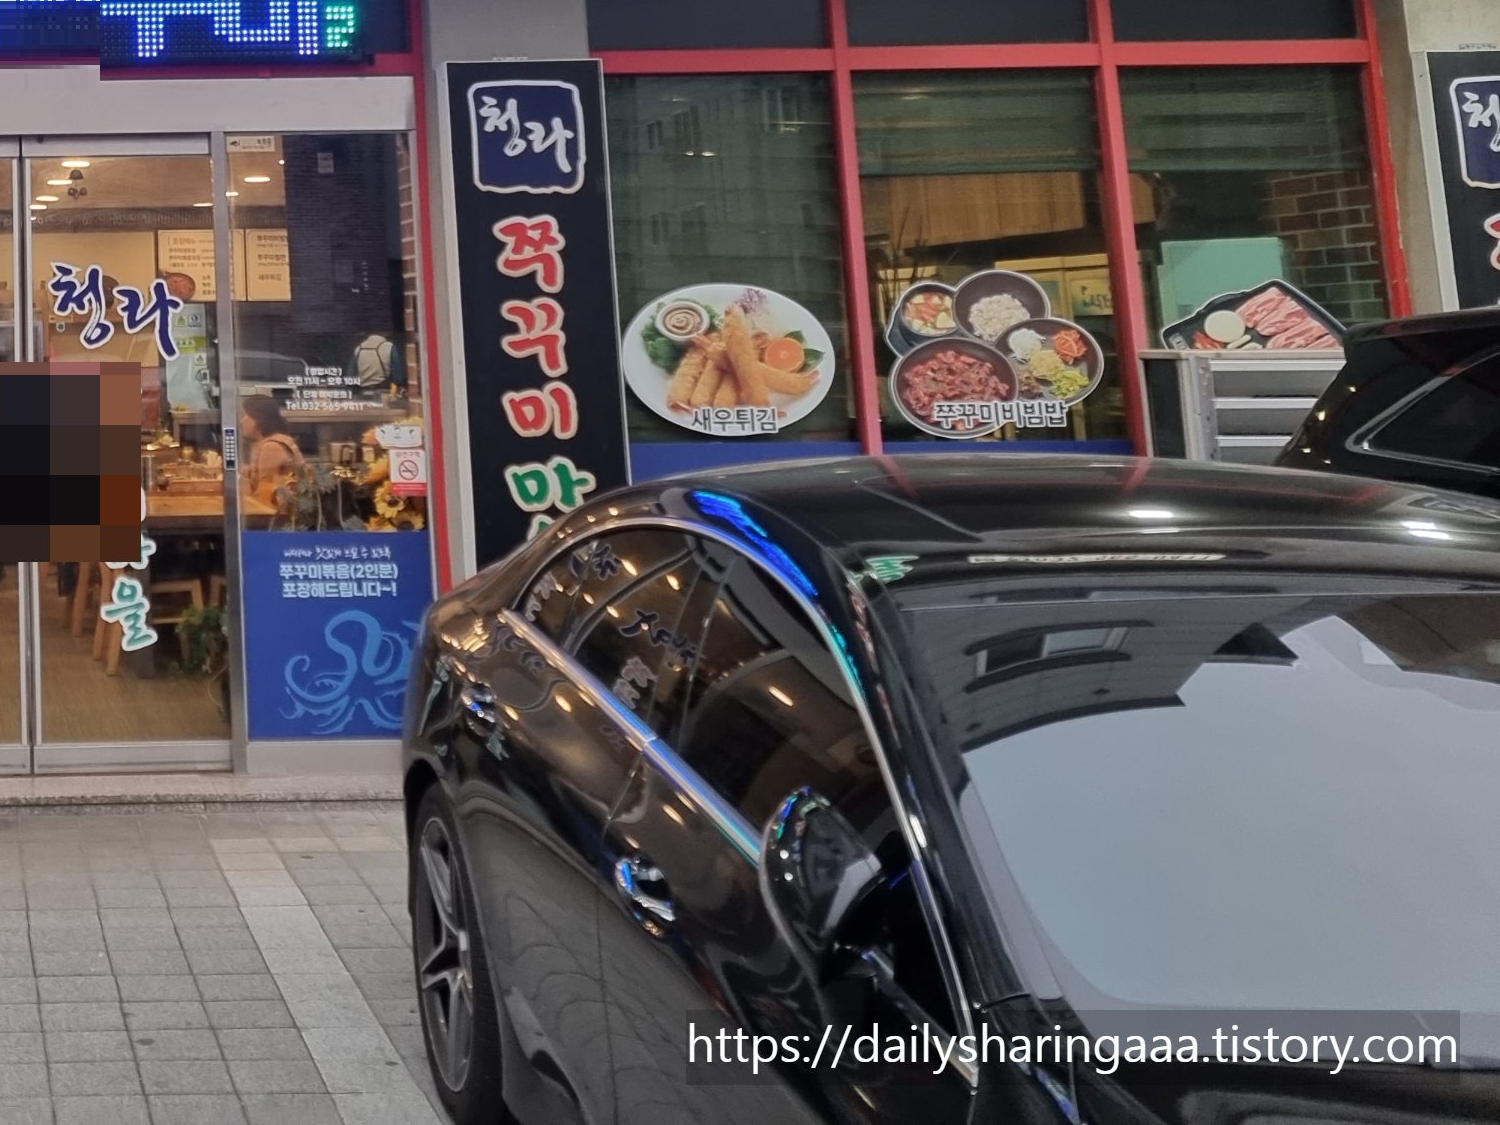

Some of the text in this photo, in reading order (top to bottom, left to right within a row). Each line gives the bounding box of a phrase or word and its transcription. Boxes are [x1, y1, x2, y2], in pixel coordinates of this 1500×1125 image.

[479, 95, 575, 173] 청라
[47, 261, 183, 360] 청라
[690, 407, 778, 433] 새우튀김
[934, 401, 1068, 429] 쭈꾸미비빔밥
